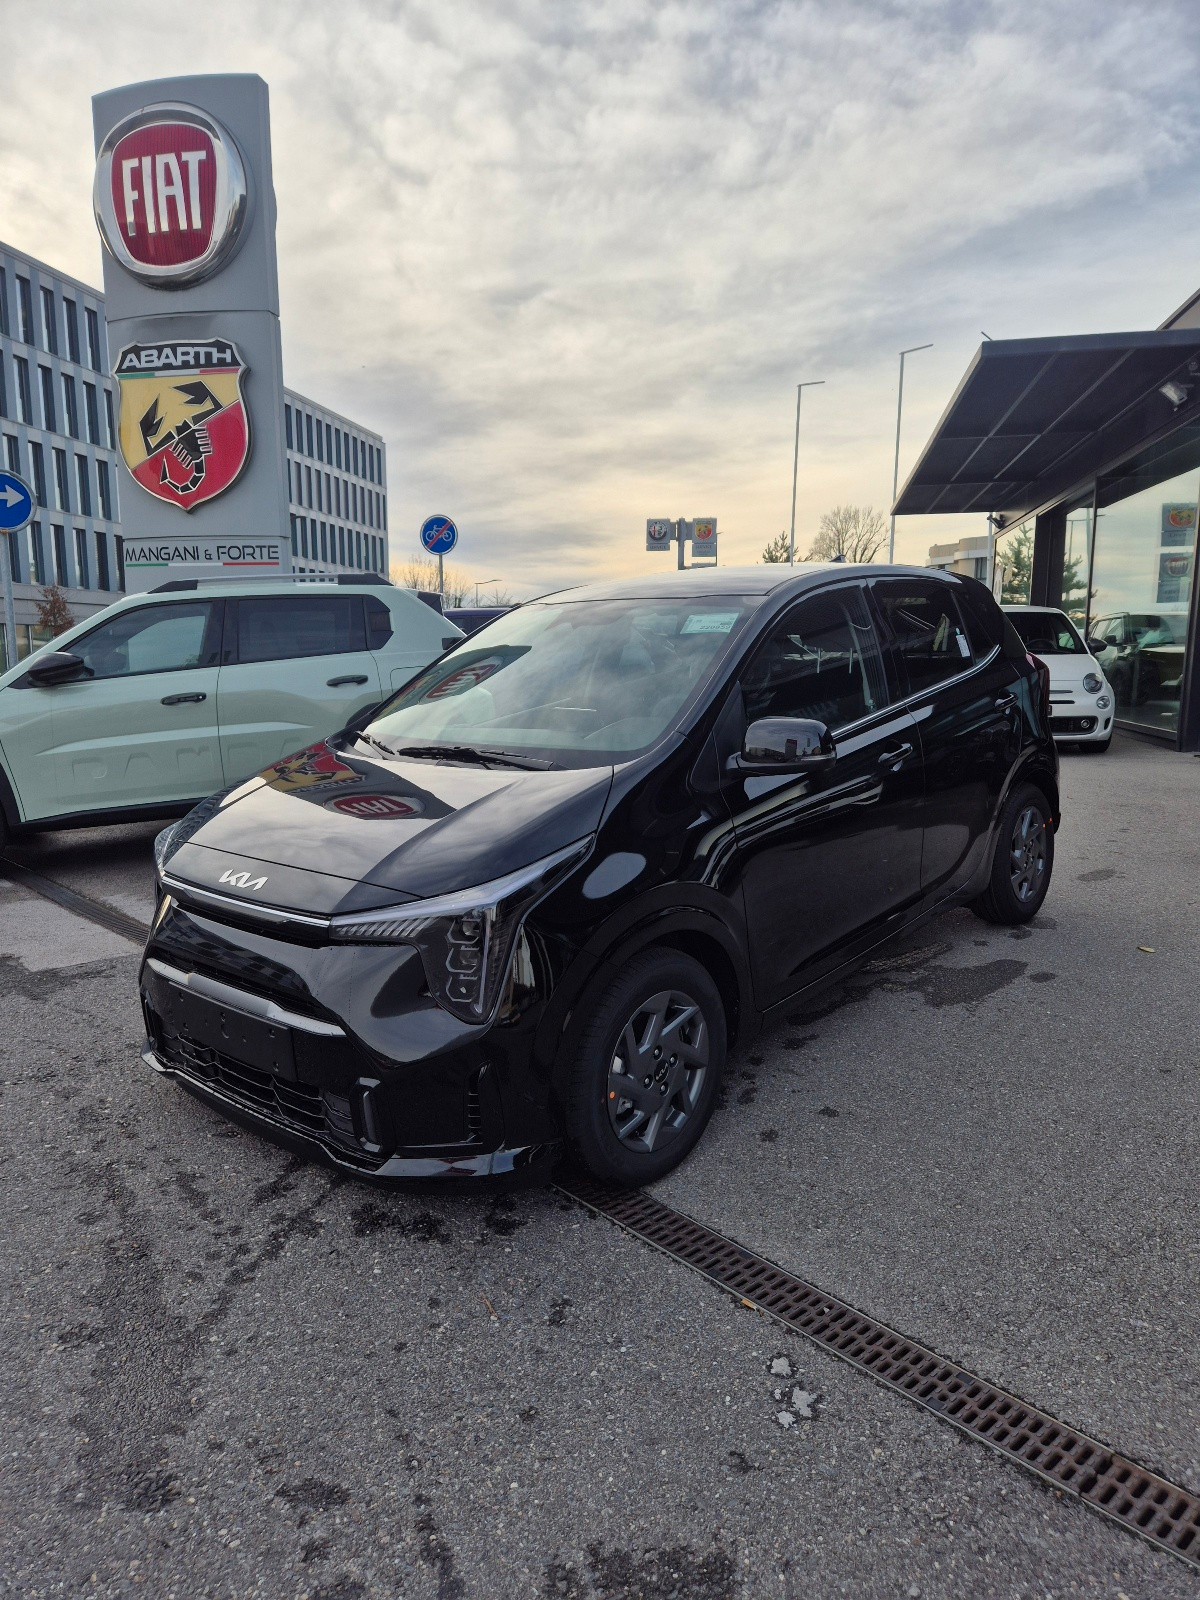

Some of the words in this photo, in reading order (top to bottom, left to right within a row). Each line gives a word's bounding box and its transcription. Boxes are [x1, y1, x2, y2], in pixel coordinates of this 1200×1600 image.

[122, 150, 207, 237] FIAT
[121, 346, 232, 370] ABARTH
[125, 545, 200, 562] MANGANI
[204, 548, 214, 561] &
[216, 545, 280, 561] FORTE
[218, 868, 269, 891] KIA
